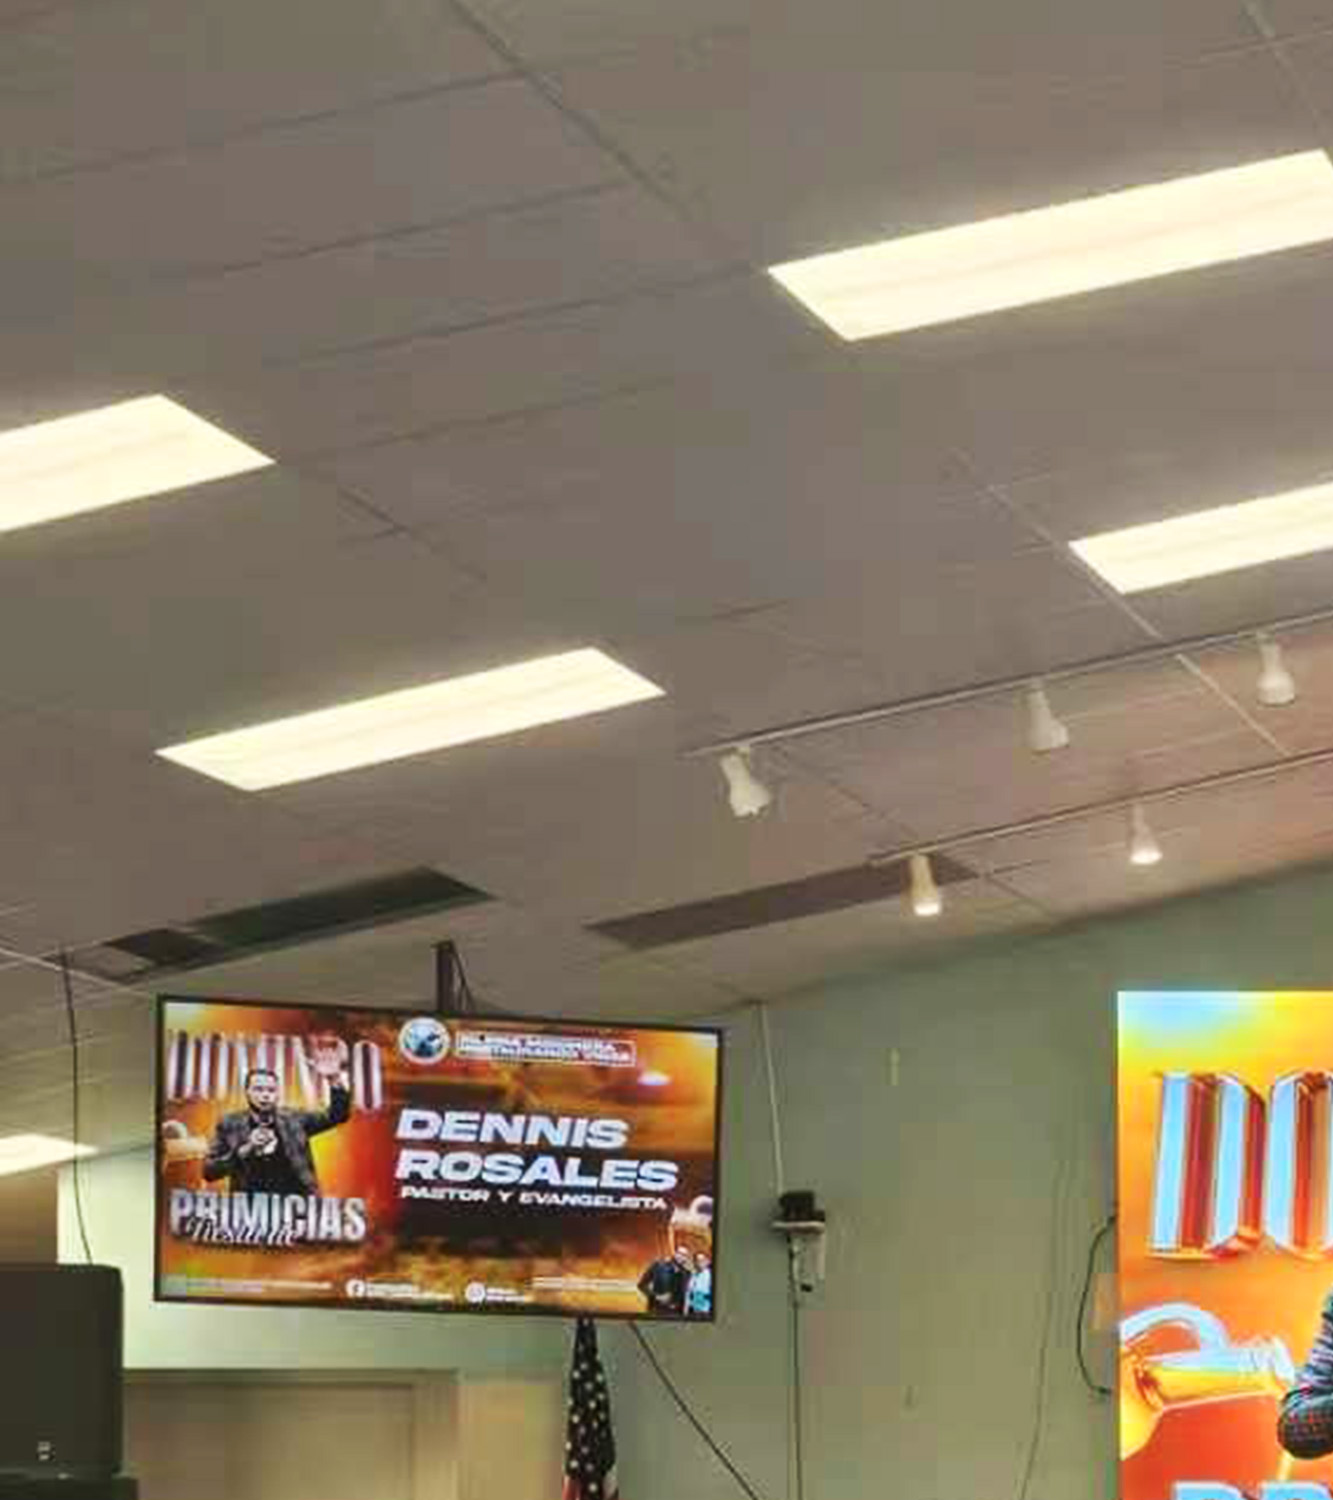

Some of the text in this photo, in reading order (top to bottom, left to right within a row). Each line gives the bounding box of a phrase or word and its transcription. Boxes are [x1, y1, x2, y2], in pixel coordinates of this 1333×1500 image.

[396, 1108, 630, 1149] DENNIS
[395, 1148, 680, 1192] ROSALES
[169, 1187, 368, 1243] PRIMICIAS
[401, 1185, 668, 1210] PASTOR Y EVANGELISTA
